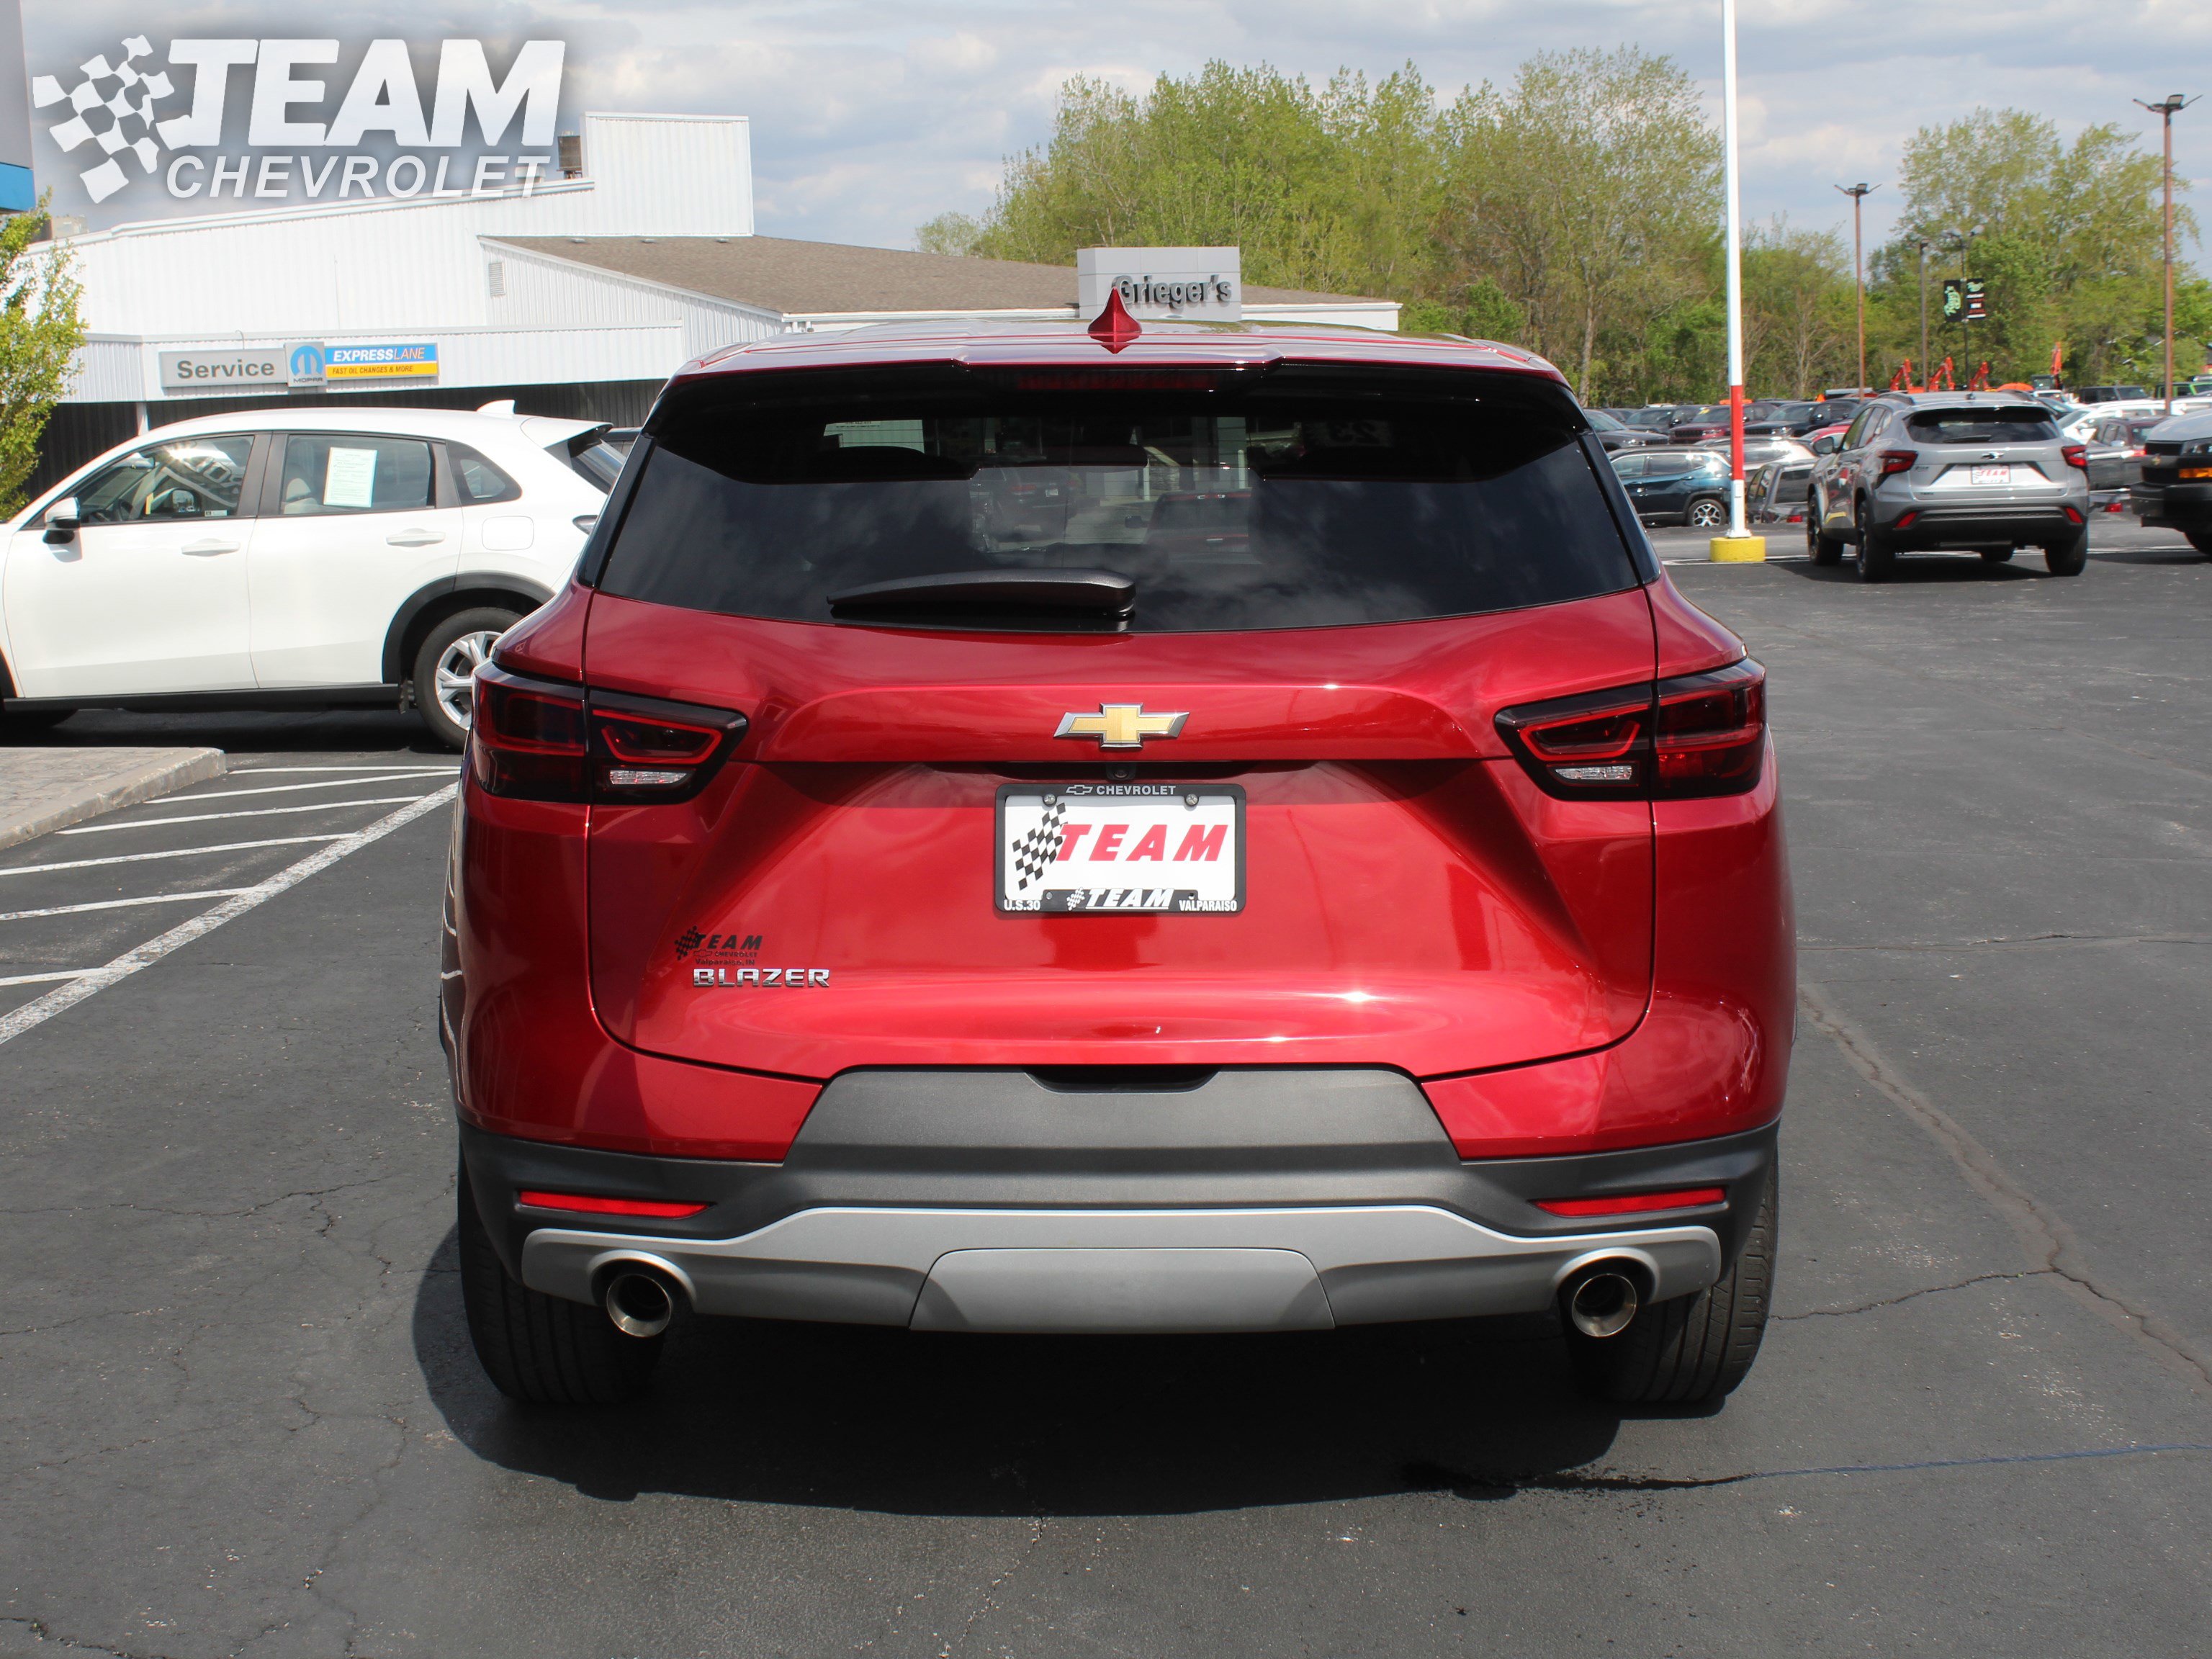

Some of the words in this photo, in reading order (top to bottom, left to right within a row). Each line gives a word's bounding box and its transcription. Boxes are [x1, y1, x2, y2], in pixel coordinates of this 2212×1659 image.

[1111, 274, 1233, 310] Grieger's
[177, 359, 275, 379] Service
[1096, 785, 1177, 796] CHEVROLET
[1056, 824, 1228, 862] TEAM
[1086, 888, 1174, 907] TEAM
[1179, 899, 1238, 912] VALPARAISO
[693, 934, 763, 950] TEAM
[693, 968, 830, 988] BLAZER
